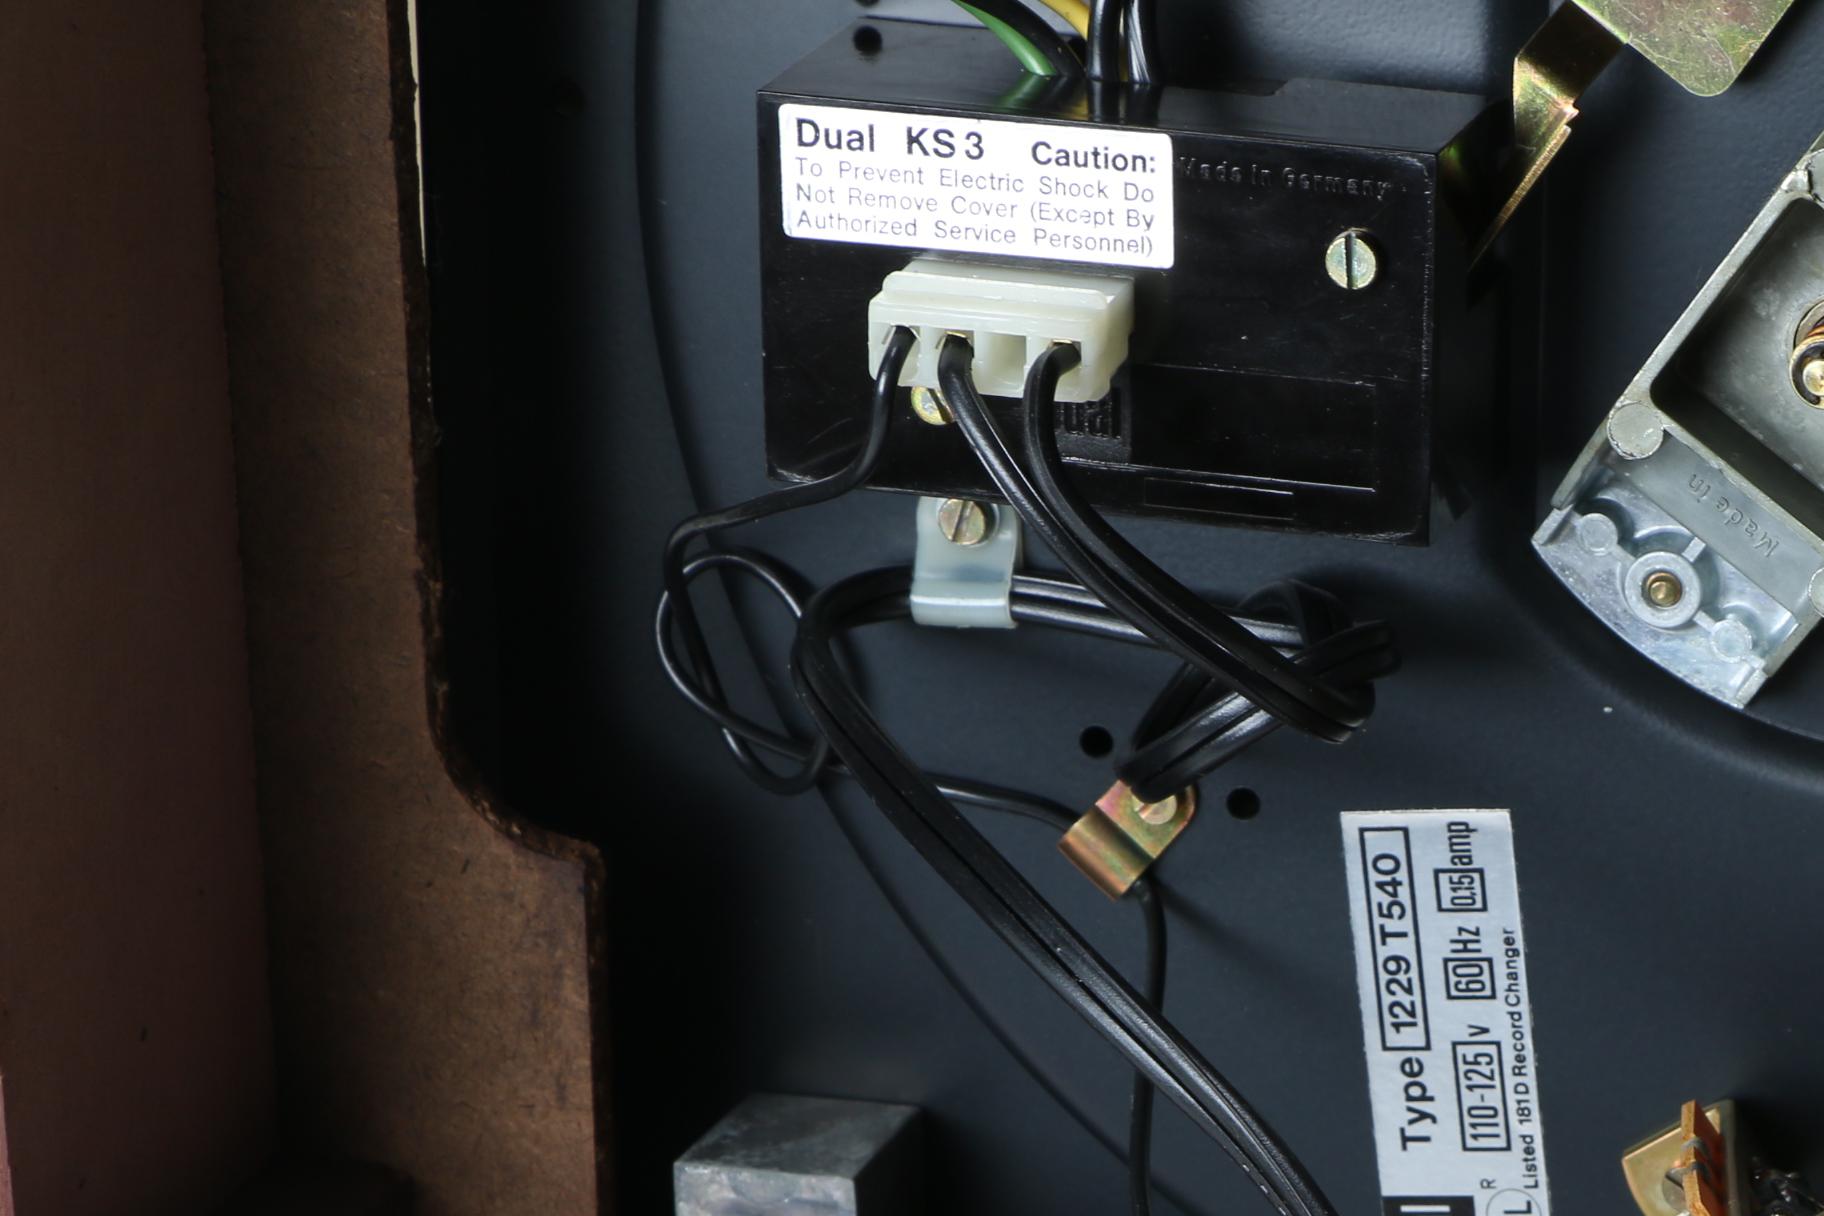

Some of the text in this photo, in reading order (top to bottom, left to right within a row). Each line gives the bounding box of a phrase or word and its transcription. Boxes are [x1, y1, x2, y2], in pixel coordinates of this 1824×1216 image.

[796, 117, 875, 152] Dual
[1031, 141, 1156, 173] Caution:
[795, 157, 1154, 202] To Prevent Electric Shock Do
[1180, 156, 1243, 182] Made
[1282, 167, 1392, 201] Germany
[796, 183, 1154, 231] Not Remove Cover (Except By
[797, 210, 1153, 257] Authorized Service Personnel)
[1688, 474, 1780, 558] Made in
[1447, 821, 1478, 866] amp
[1450, 926, 1482, 953] Hz
[1452, 963, 1486, 993] 60
[1503, 928, 1521, 1006] Changer
[1372, 853, 1437, 1151] Type 1229 T540
[1506, 1011, 1529, 1076] Record
[1462, 1053, 1501, 1142] 110-125
[1480, 1178, 1496, 1189] R
[1519, 1134, 1539, 1189] Listed
